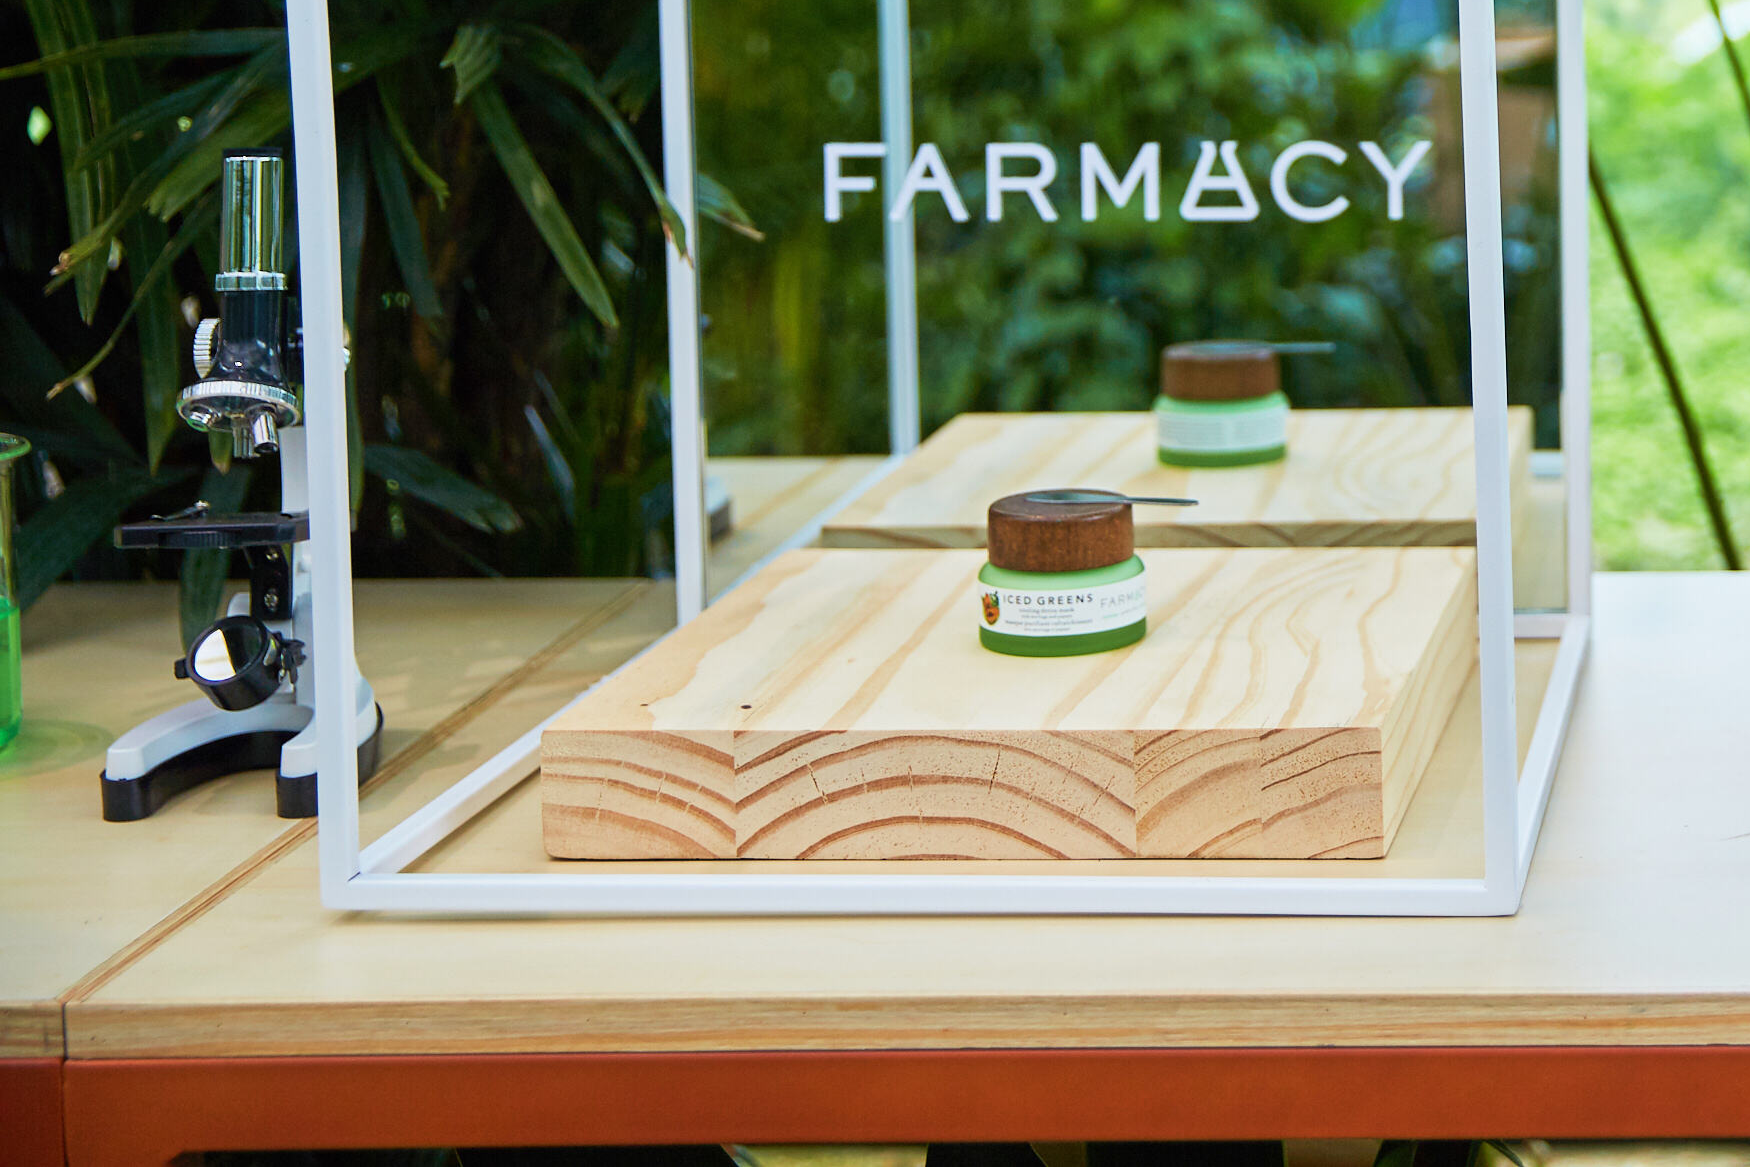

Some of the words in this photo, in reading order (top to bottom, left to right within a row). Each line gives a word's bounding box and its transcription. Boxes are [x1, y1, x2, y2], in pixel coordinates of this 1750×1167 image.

[822, 141, 1433, 222] FARMACY
[1003, 594, 1032, 606] ICED
[1037, 593, 1094, 606] GREENS
